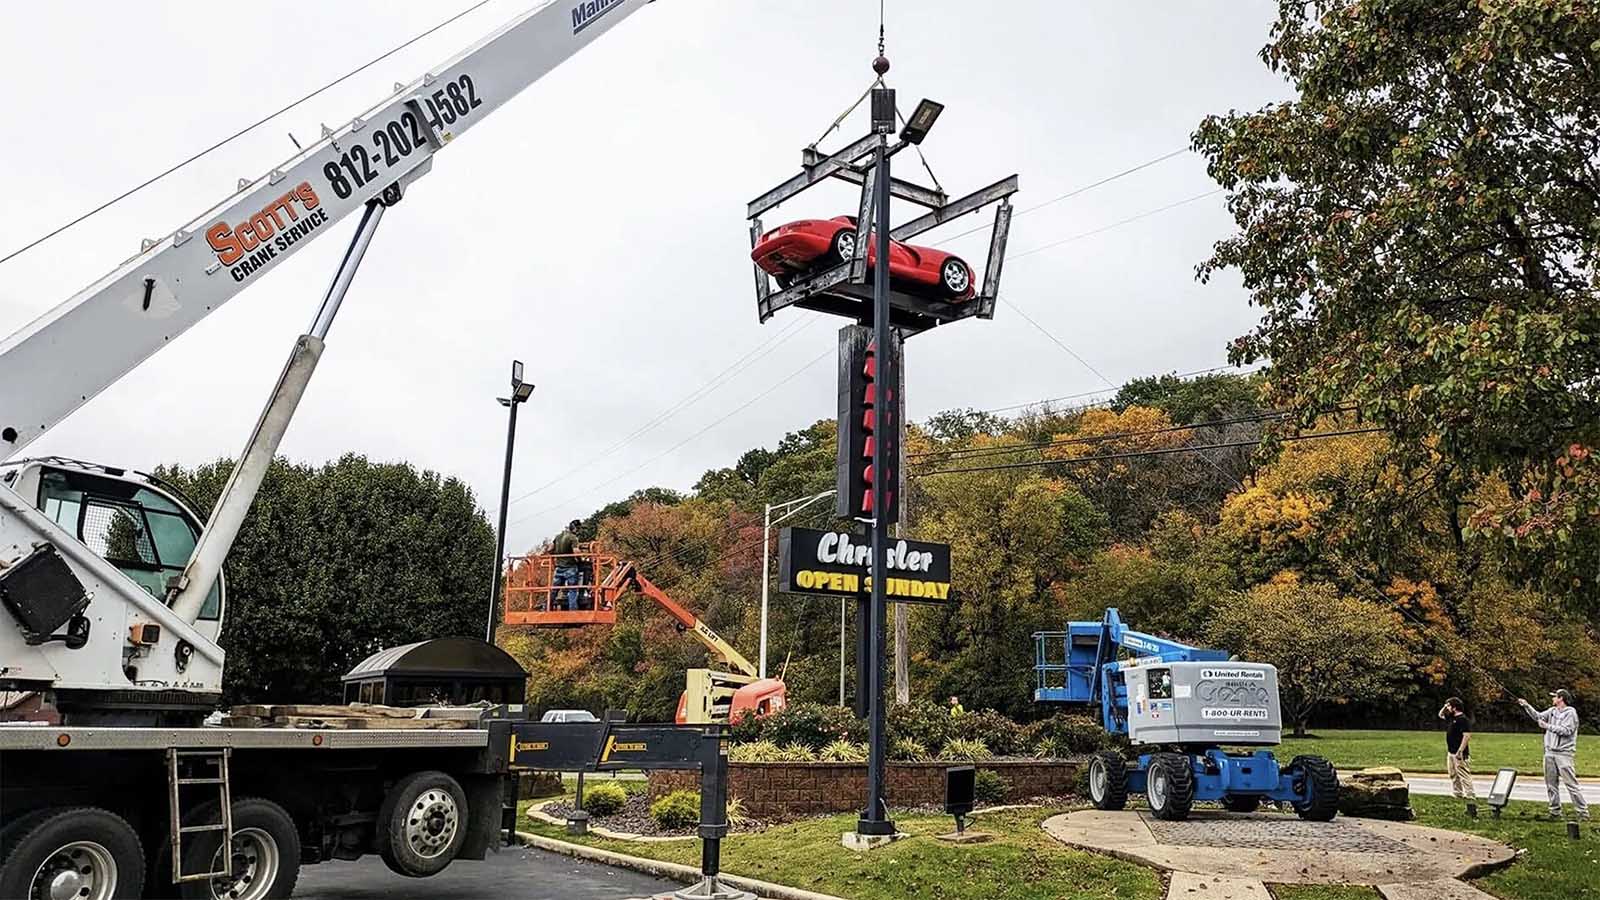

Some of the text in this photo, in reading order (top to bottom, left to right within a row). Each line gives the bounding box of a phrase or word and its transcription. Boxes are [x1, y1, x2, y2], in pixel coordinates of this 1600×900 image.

[571, 0, 615, 28] Man
[323, 74, 482, 199] 812-2024582
[230, 207, 329, 282] CRANE SERVICE
[796, 569, 859, 593] OPEN
[1214, 670, 1263, 679] United Rentals
